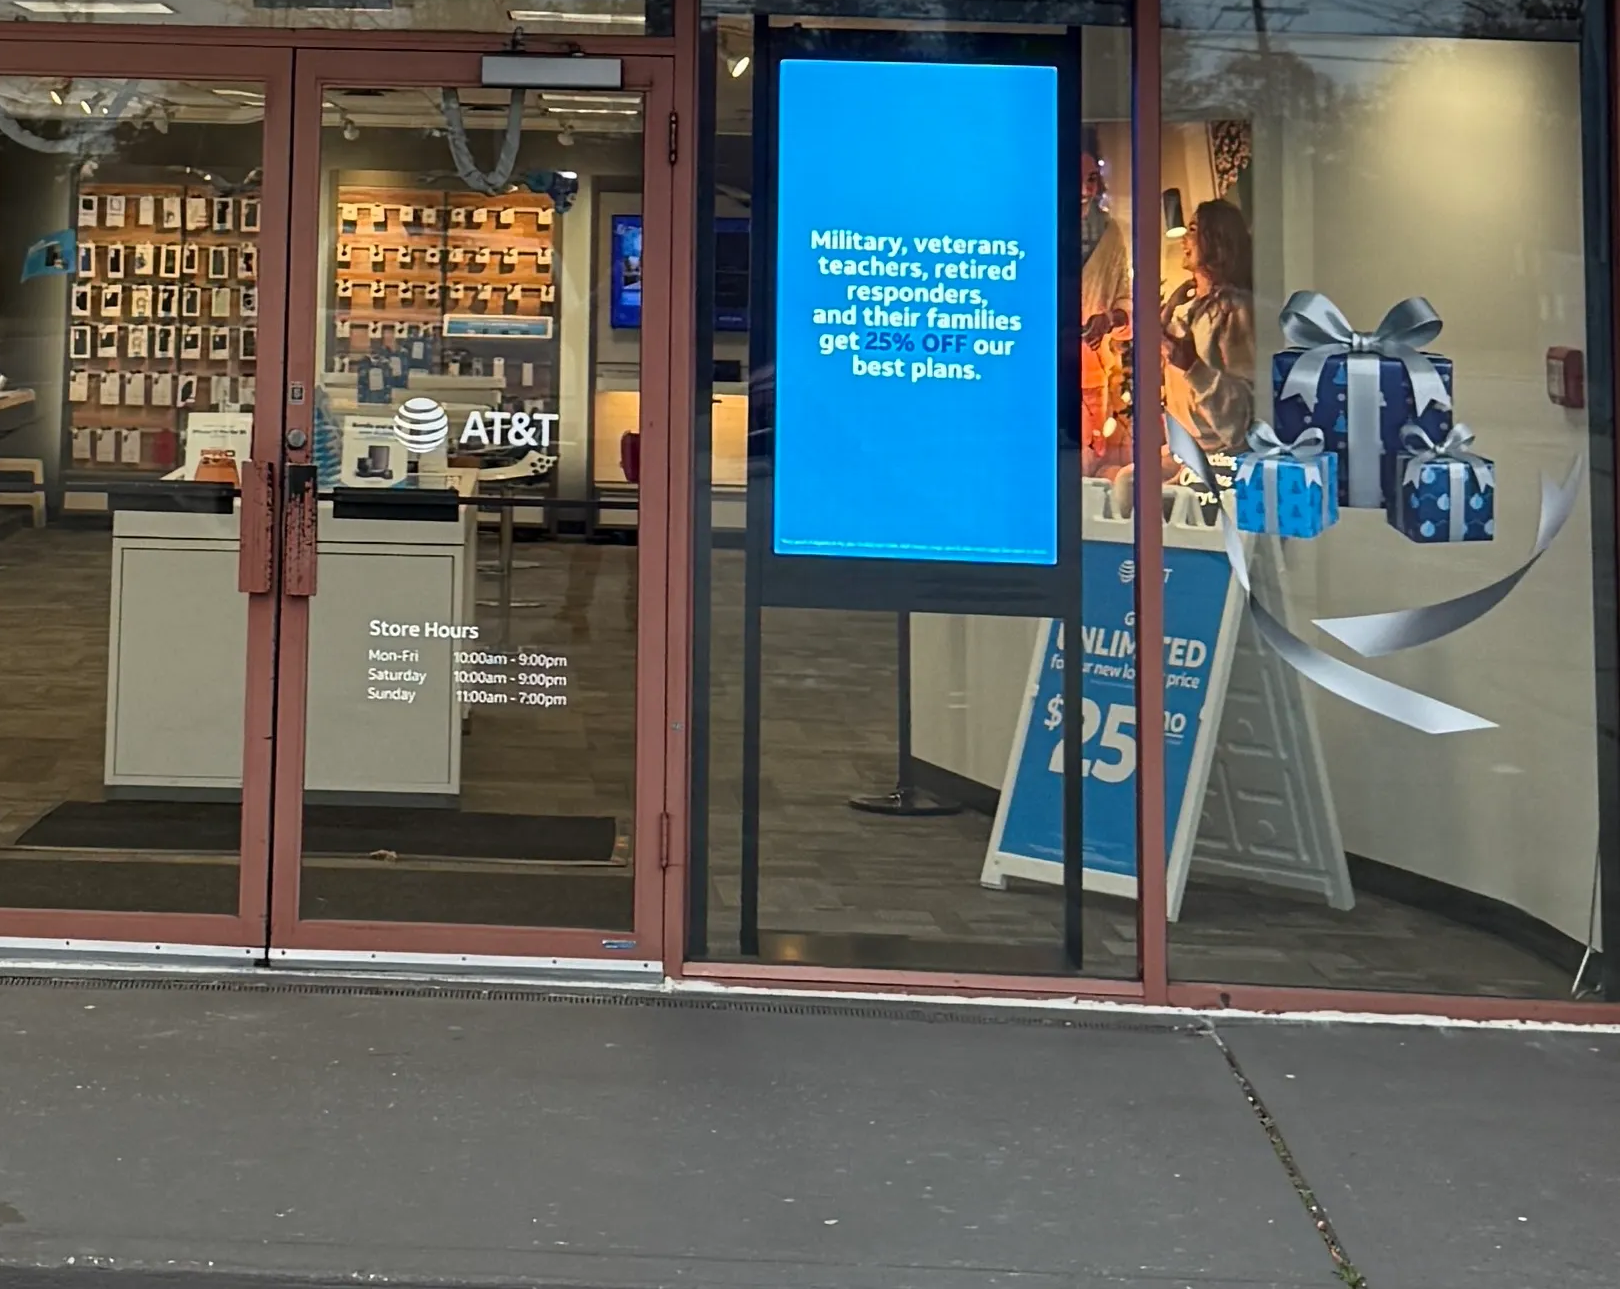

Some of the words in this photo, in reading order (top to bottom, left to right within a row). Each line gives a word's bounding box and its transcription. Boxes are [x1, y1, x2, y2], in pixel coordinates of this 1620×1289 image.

[810, 230, 908, 257] Military,
[913, 234, 1025, 261] veterans,
[818, 255, 929, 283] teachers,
[934, 259, 1017, 282] retired
[847, 281, 988, 308] responders,
[812, 304, 857, 327] and
[862, 305, 921, 328] their
[926, 307, 1022, 332] families
[819, 332, 860, 356] get
[864, 331, 916, 355] 25%
[921, 333, 968, 355] OFF
[973, 338, 1015, 357] our
[852, 356, 905, 379] best
[911, 358, 981, 383] plans.
[459, 409, 560, 448] AT&T
[369, 619, 421, 638] Store
[424, 621, 480, 640] Hours
[1056, 622, 1208, 669] NLIMED
[368, 649, 420, 663] Mon-Fri
[453, 651, 508, 666] 10:00am
[518, 653, 568, 670] 9:00pm
[368, 667, 428, 685] Saturday
[453, 670, 508, 686] 10:00am
[518, 672, 568, 689] 9:00pm
[1093, 664, 1122, 679] new
[1166, 673, 1201, 690] price
[367, 686, 417, 704] Sunday
[456, 690, 508, 705] 11:00am
[518, 692, 568, 708] 7:00pm
